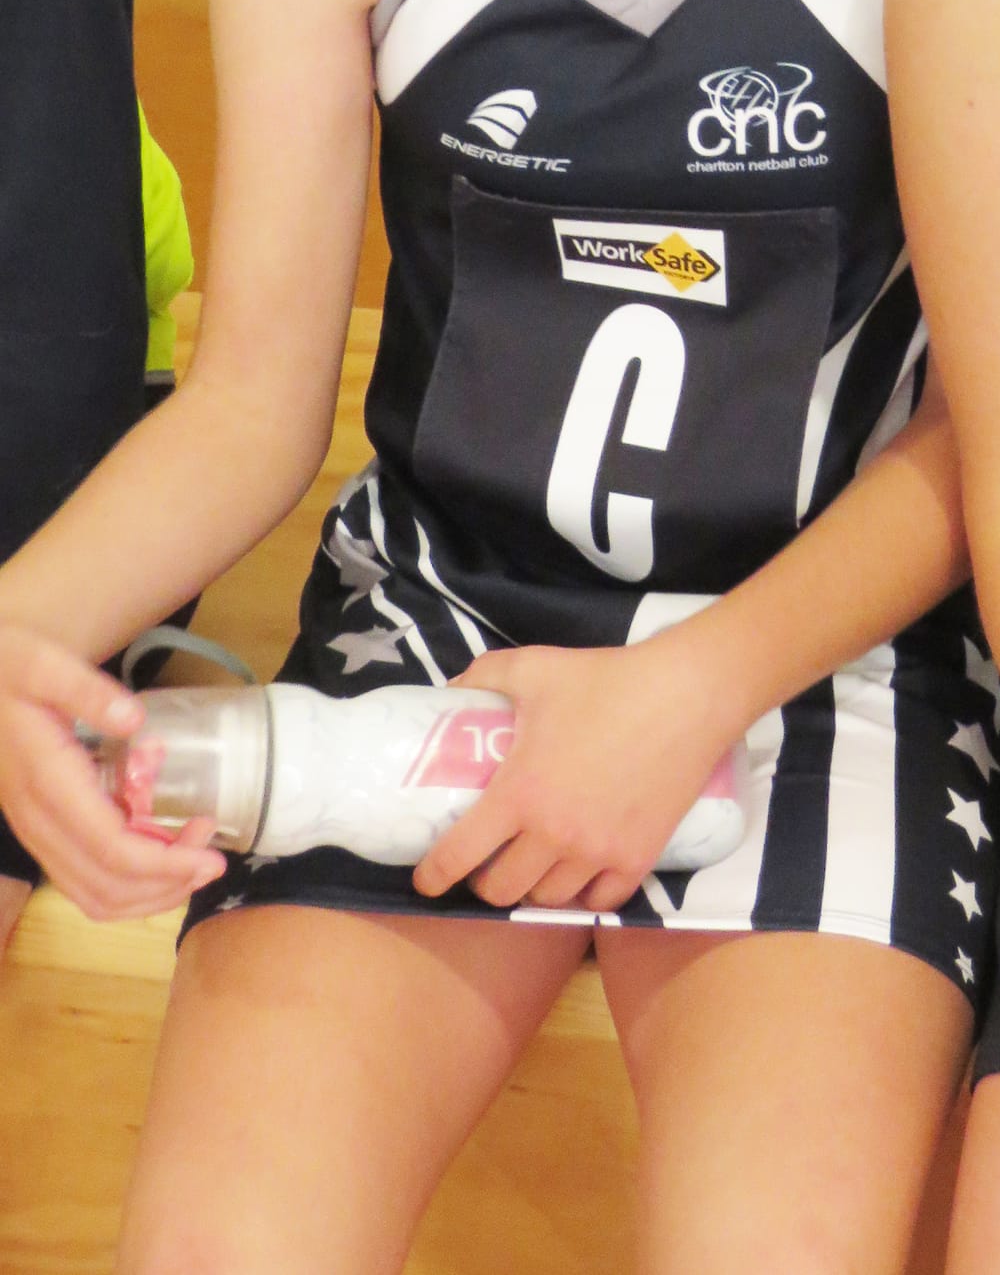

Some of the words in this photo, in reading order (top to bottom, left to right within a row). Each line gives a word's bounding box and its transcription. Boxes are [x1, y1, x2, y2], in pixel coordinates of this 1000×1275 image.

[440, 132, 572, 173] ENERGETIC
[687, 101, 828, 157] cnc
[686, 160, 745, 173] charlton
[748, 156, 796, 171] netball
[798, 153, 829, 167] club
[545, 303, 686, 583] C
